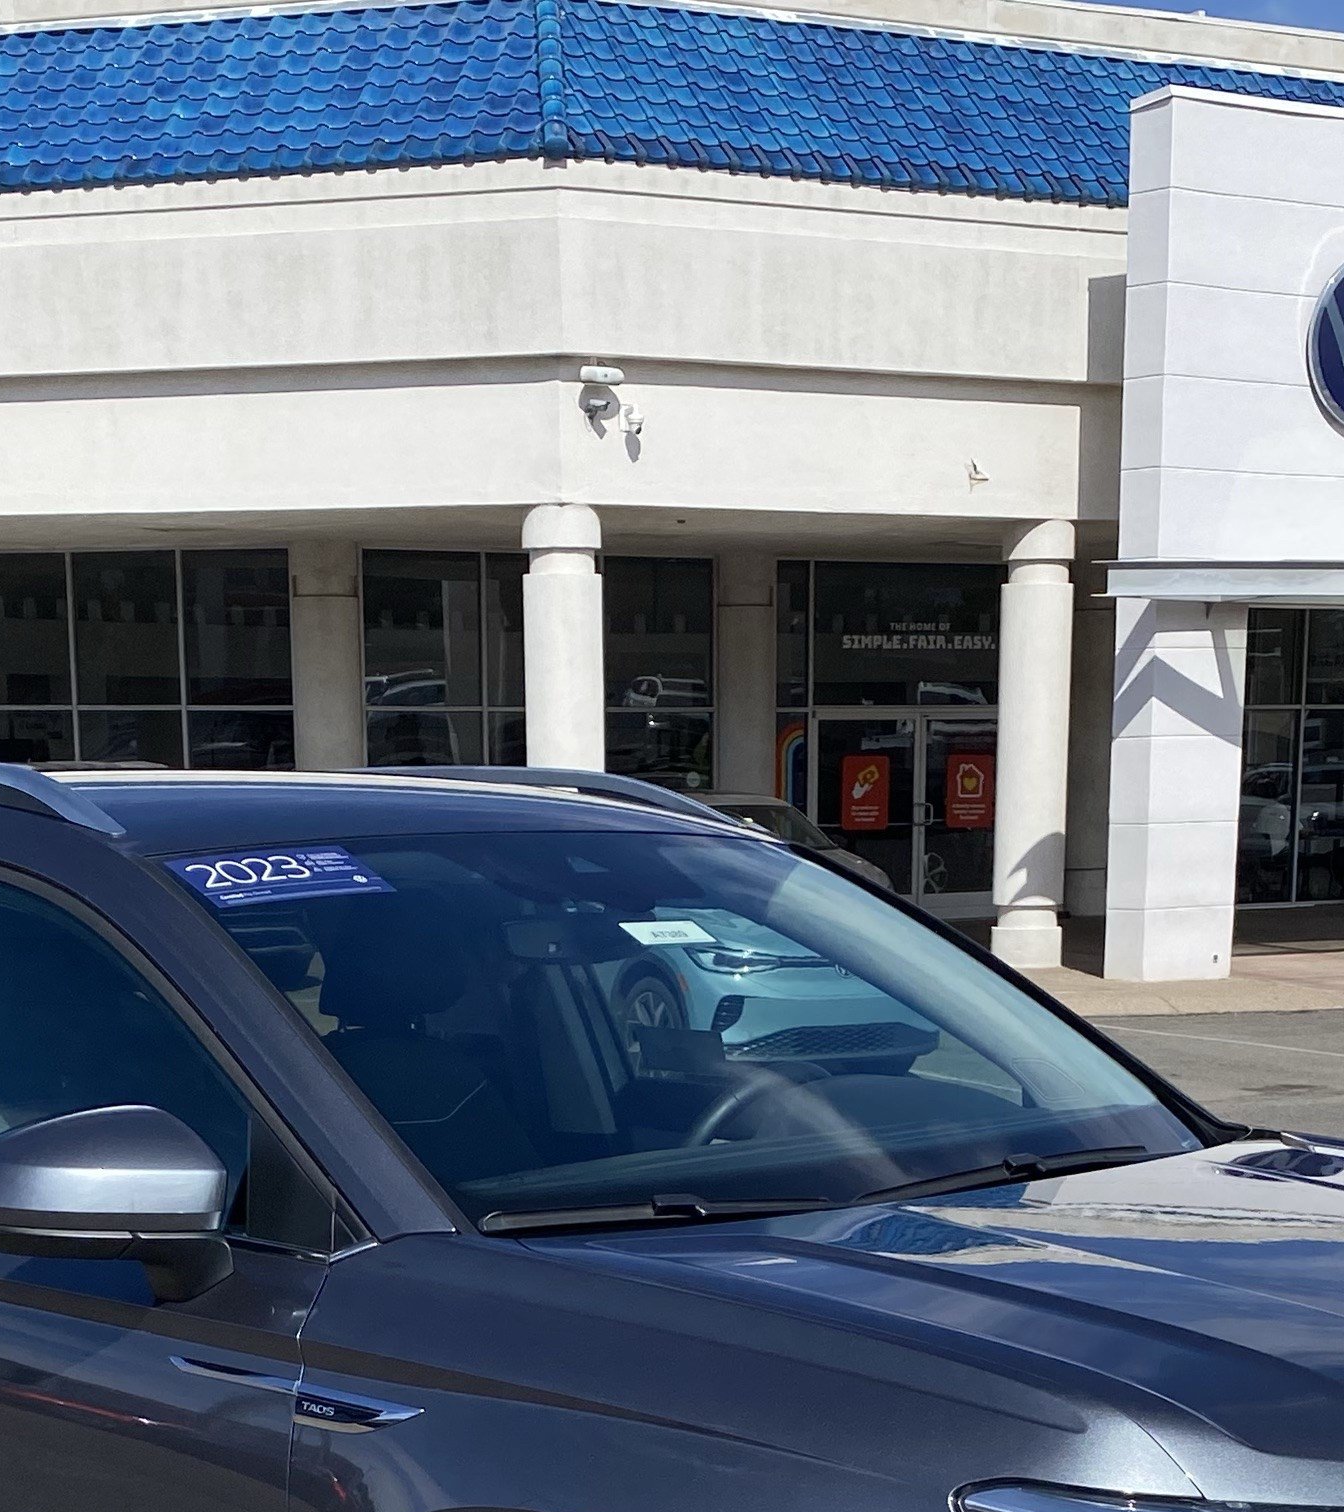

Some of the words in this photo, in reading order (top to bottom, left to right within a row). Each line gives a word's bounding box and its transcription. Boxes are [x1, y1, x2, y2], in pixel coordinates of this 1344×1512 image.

[890, 622, 906, 631] THE
[909, 622, 936, 631] HOME
[185, 855, 311, 888] 2023
[301, 1401, 335, 1416] TAOS
